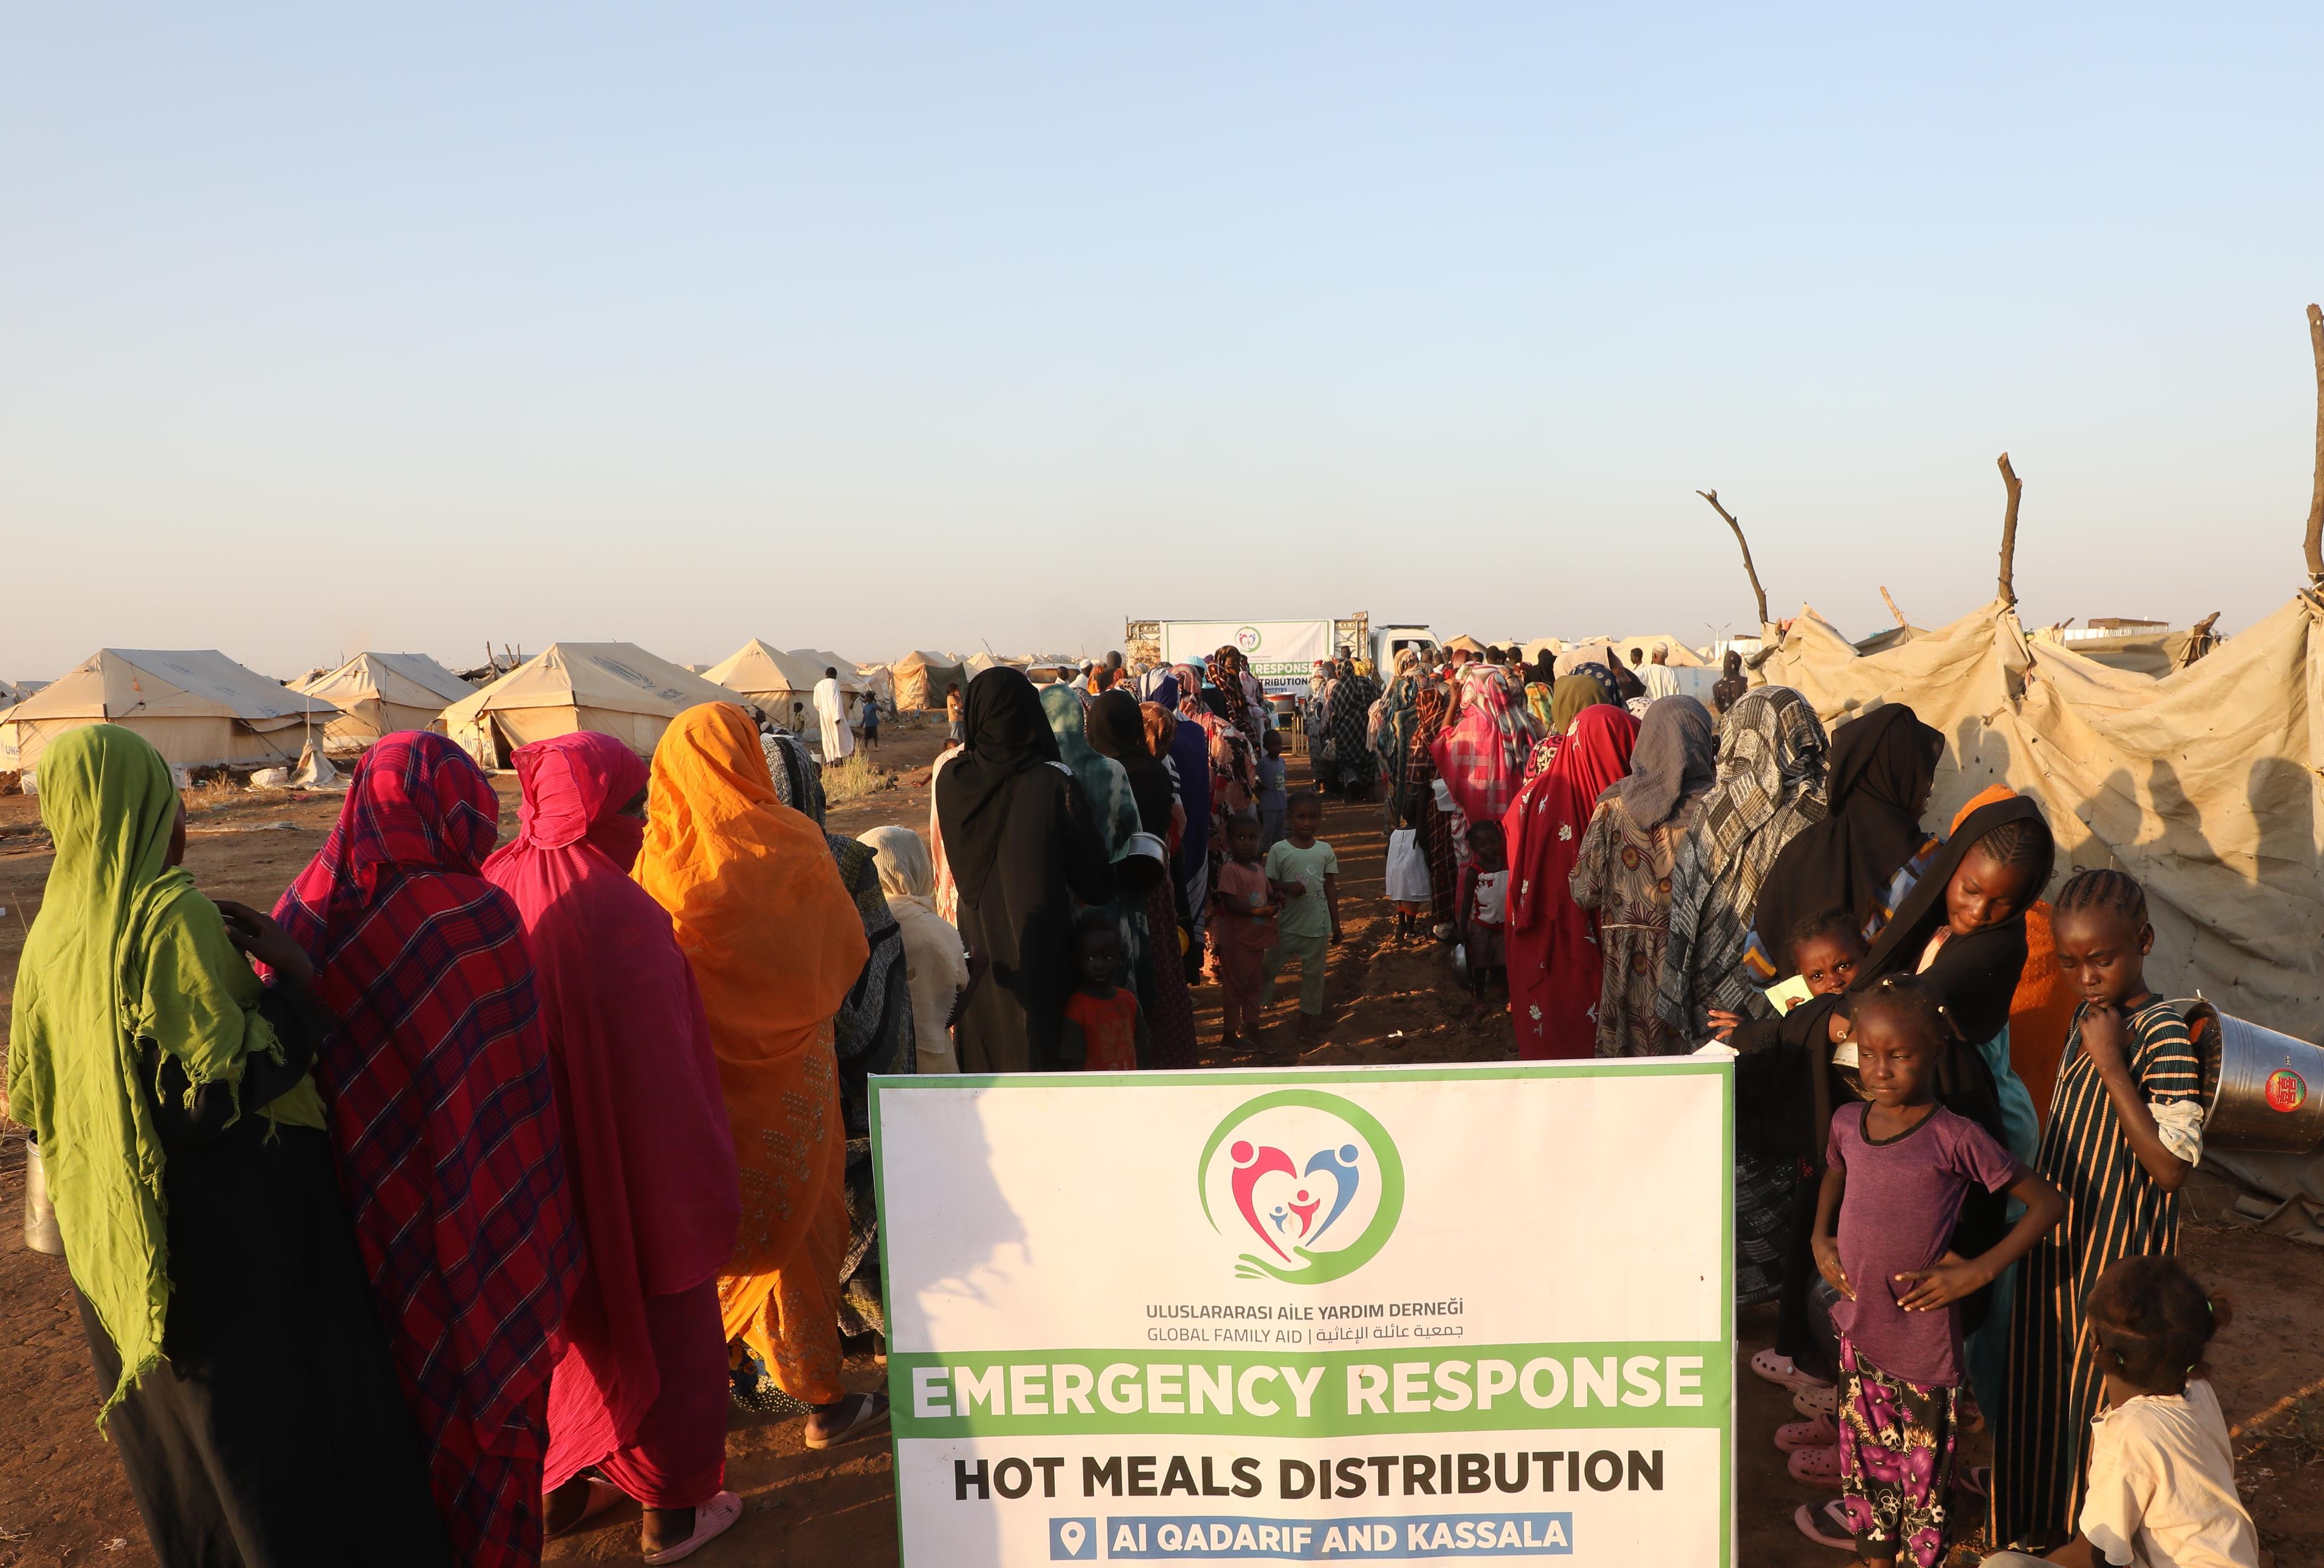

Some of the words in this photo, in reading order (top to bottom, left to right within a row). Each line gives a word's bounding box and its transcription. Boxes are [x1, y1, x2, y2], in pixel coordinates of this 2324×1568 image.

[1259, 678, 1307, 686] TRIBUTION
[5, 745, 19, 756] UNH
[1147, 1305, 1272, 1320] ULUSLARARASI
[1278, 1303, 1313, 1320] AİLE
[1318, 1304, 1384, 1320] YARDIM
[1390, 1297, 1463, 1317] DERNEĞİ
[1147, 1328, 1210, 1341] GLOBAL
[1215, 1328, 1270, 1343] FAMILY
[1276, 1330, 1302, 1343] AID
[1316, 1326, 1368, 1344] الإغاثية
[1373, 1324, 1410, 1339] عائلة
[1414, 1324, 1463, 1339] جمعية
[912, 1363, 1325, 1418] EMERGENCY
[1347, 1356, 1703, 1415] RESPONSE
[954, 1457, 1065, 1501] HOT
[1083, 1455, 1262, 1497] MEALS
[1280, 1450, 1663, 1500] DISTRIBUTION
[1157, 1523, 1313, 1553] QADARIF
[1321, 1524, 1397, 1553] AND
[1407, 1520, 1569, 1551] KASSALA
